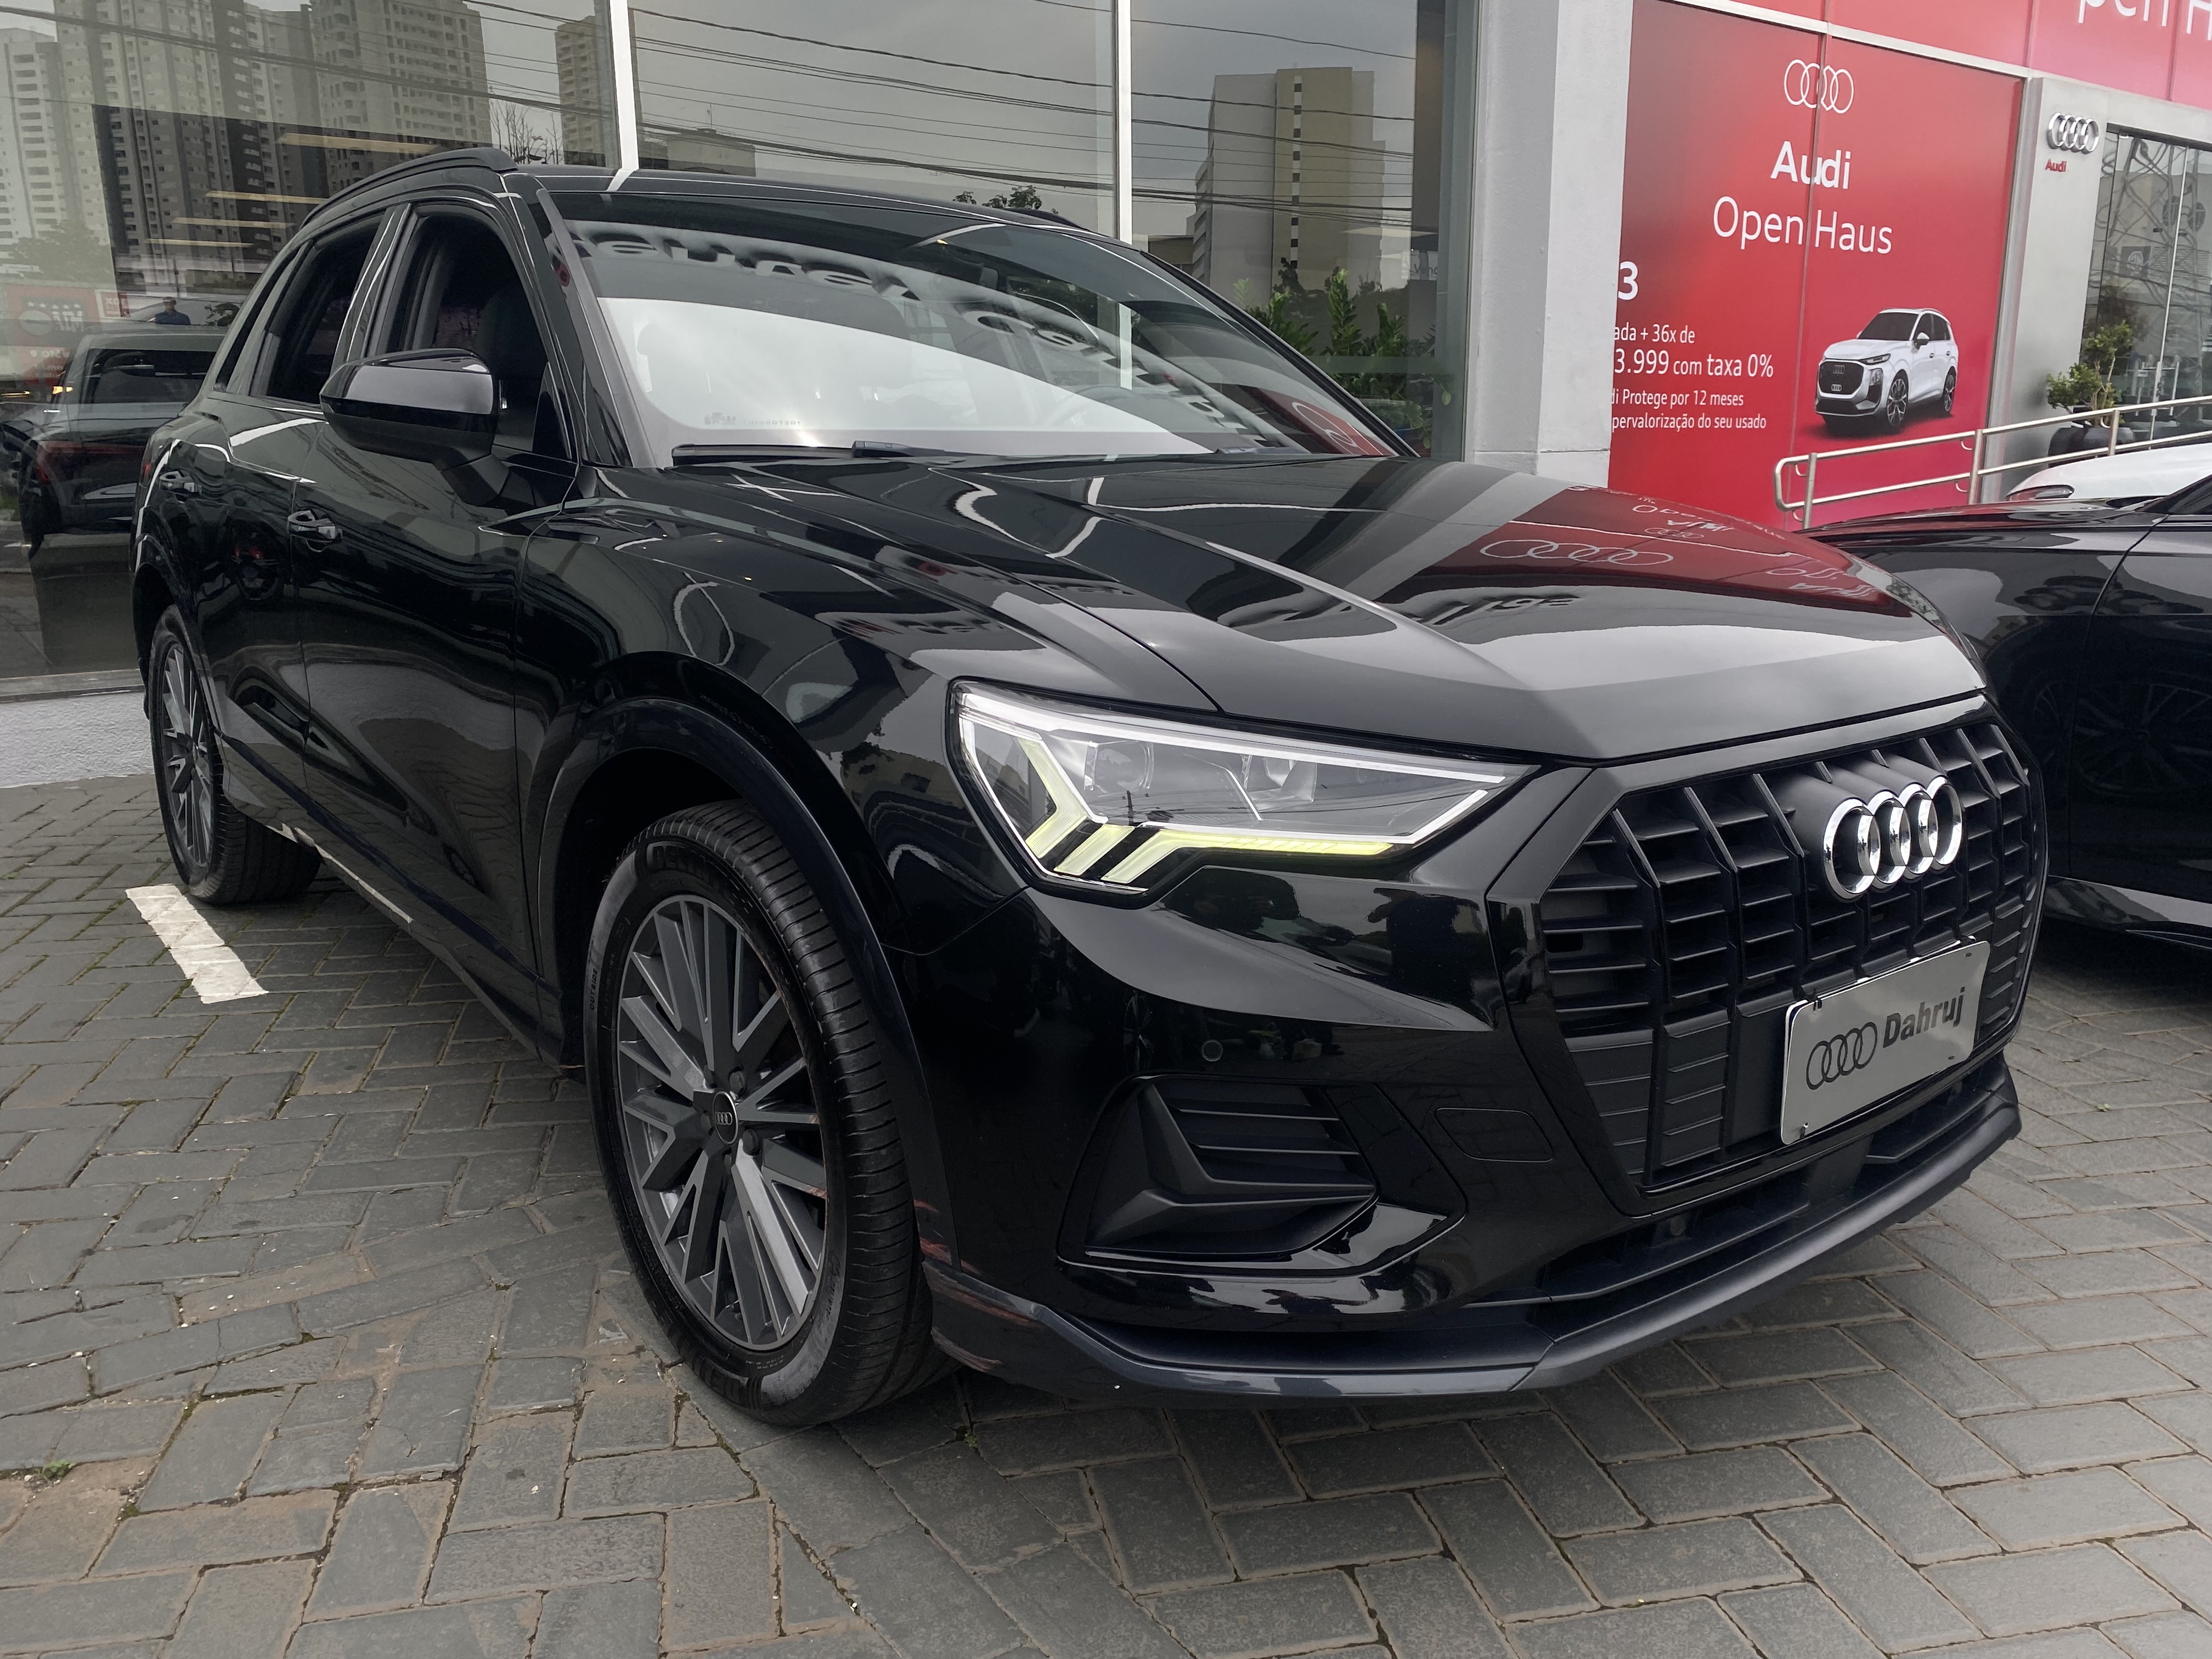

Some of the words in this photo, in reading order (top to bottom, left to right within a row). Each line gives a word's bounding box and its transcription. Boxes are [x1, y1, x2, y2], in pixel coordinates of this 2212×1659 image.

[1770, 140, 1852, 189] Audi
[2045, 159, 2067, 172] Audi
[1713, 196, 1804, 250] Open
[1815, 210, 1893, 255] Haus
[1652, 324, 1677, 343] 36x
[1680, 325, 1696, 343] de
[1615, 348, 1669, 375] 3.999
[1673, 360, 1702, 375] com
[1707, 354, 1742, 377] taxa
[1747, 354, 1774, 377] 0%
[1622, 388, 1668, 409] Protege
[1671, 393, 1690, 409] por
[1694, 390, 1707, 406] 12
[1710, 394, 1744, 406] meses
[1612, 413, 1695, 432] pervalorização
[1697, 413, 1711, 428] do
[1714, 416, 1733, 428] seu
[1736, 414, 1767, 429] usado
[589, 967, 598, 1011] OUTSIDE
[1882, 986, 1966, 1048] Dahruj
